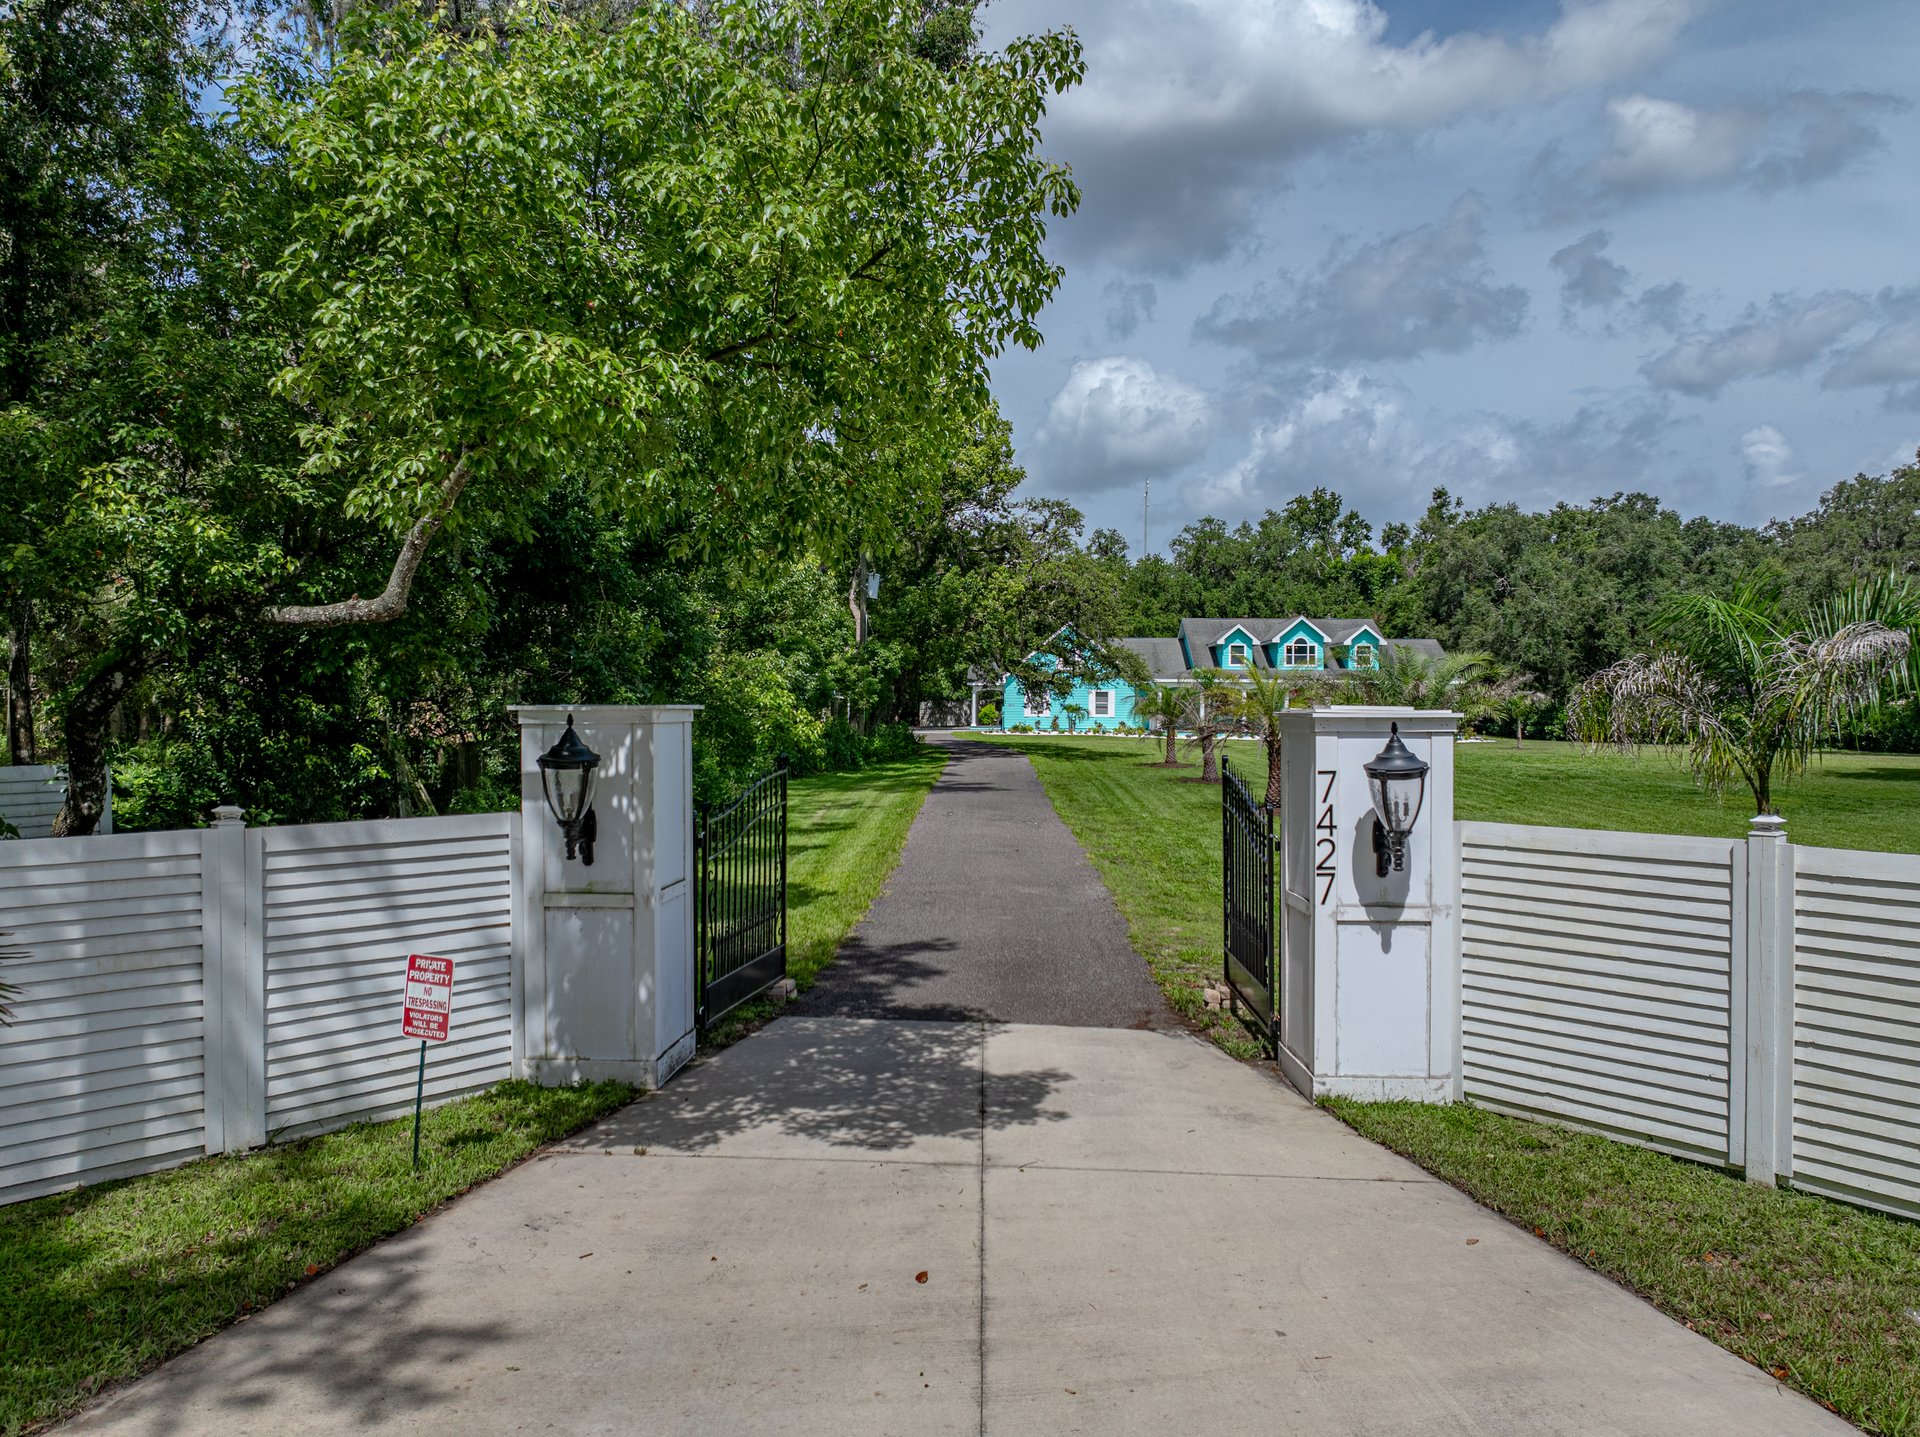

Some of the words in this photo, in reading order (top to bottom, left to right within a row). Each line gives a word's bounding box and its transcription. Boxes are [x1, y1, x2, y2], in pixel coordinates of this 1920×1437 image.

[1316, 770, 1337, 905] 7427
[415, 958, 446, 971] PRIVATE
[409, 970, 450, 984] PROPERTY
[424, 986, 432, 996] NO
[408, 997, 447, 1011] TRESPASSING
[409, 1011, 443, 1022] VIOLATORS
[412, 1020, 427, 1028] WILL
[430, 1022, 438, 1030] BE
[405, 1027, 445, 1038] PROSECUTED
